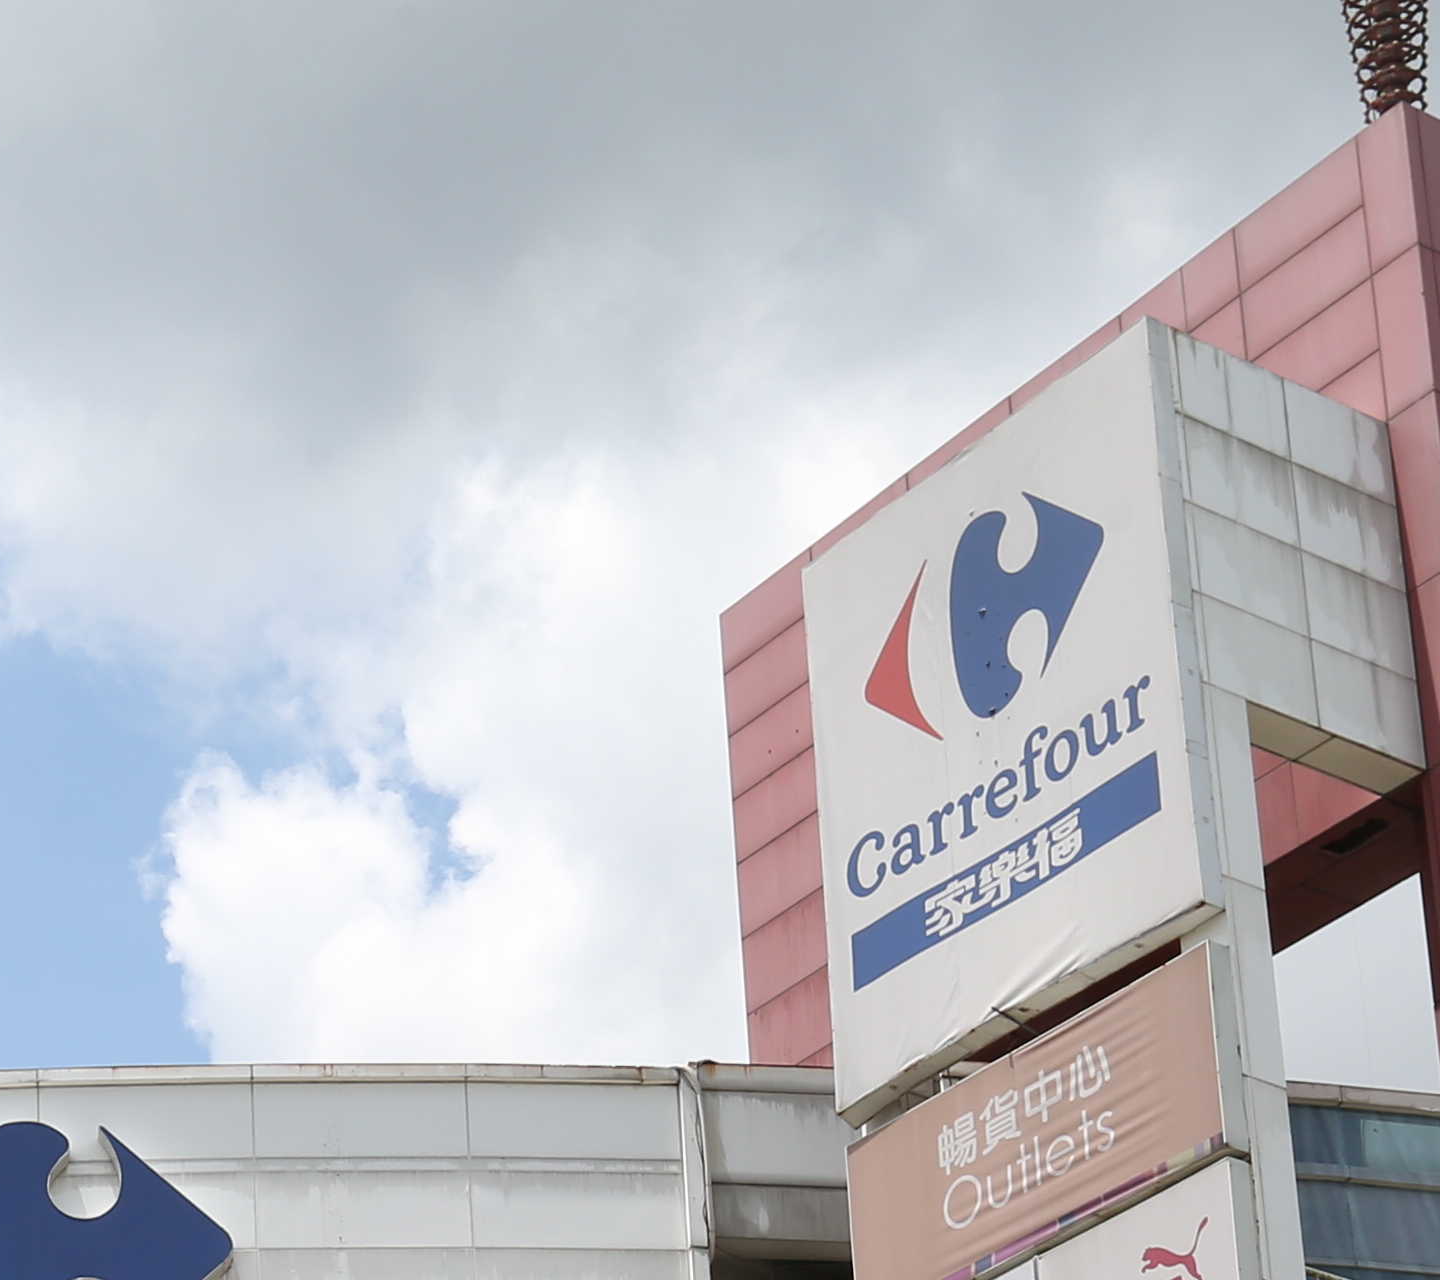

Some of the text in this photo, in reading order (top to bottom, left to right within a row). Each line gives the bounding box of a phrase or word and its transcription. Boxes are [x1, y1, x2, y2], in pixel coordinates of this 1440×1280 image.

[846, 674, 1151, 898] Carrefour
[924, 807, 1083, 938] 家樂福
[936, 1045, 1112, 1175] 暢貨中心
[942, 1109, 1115, 1229] Outlets
